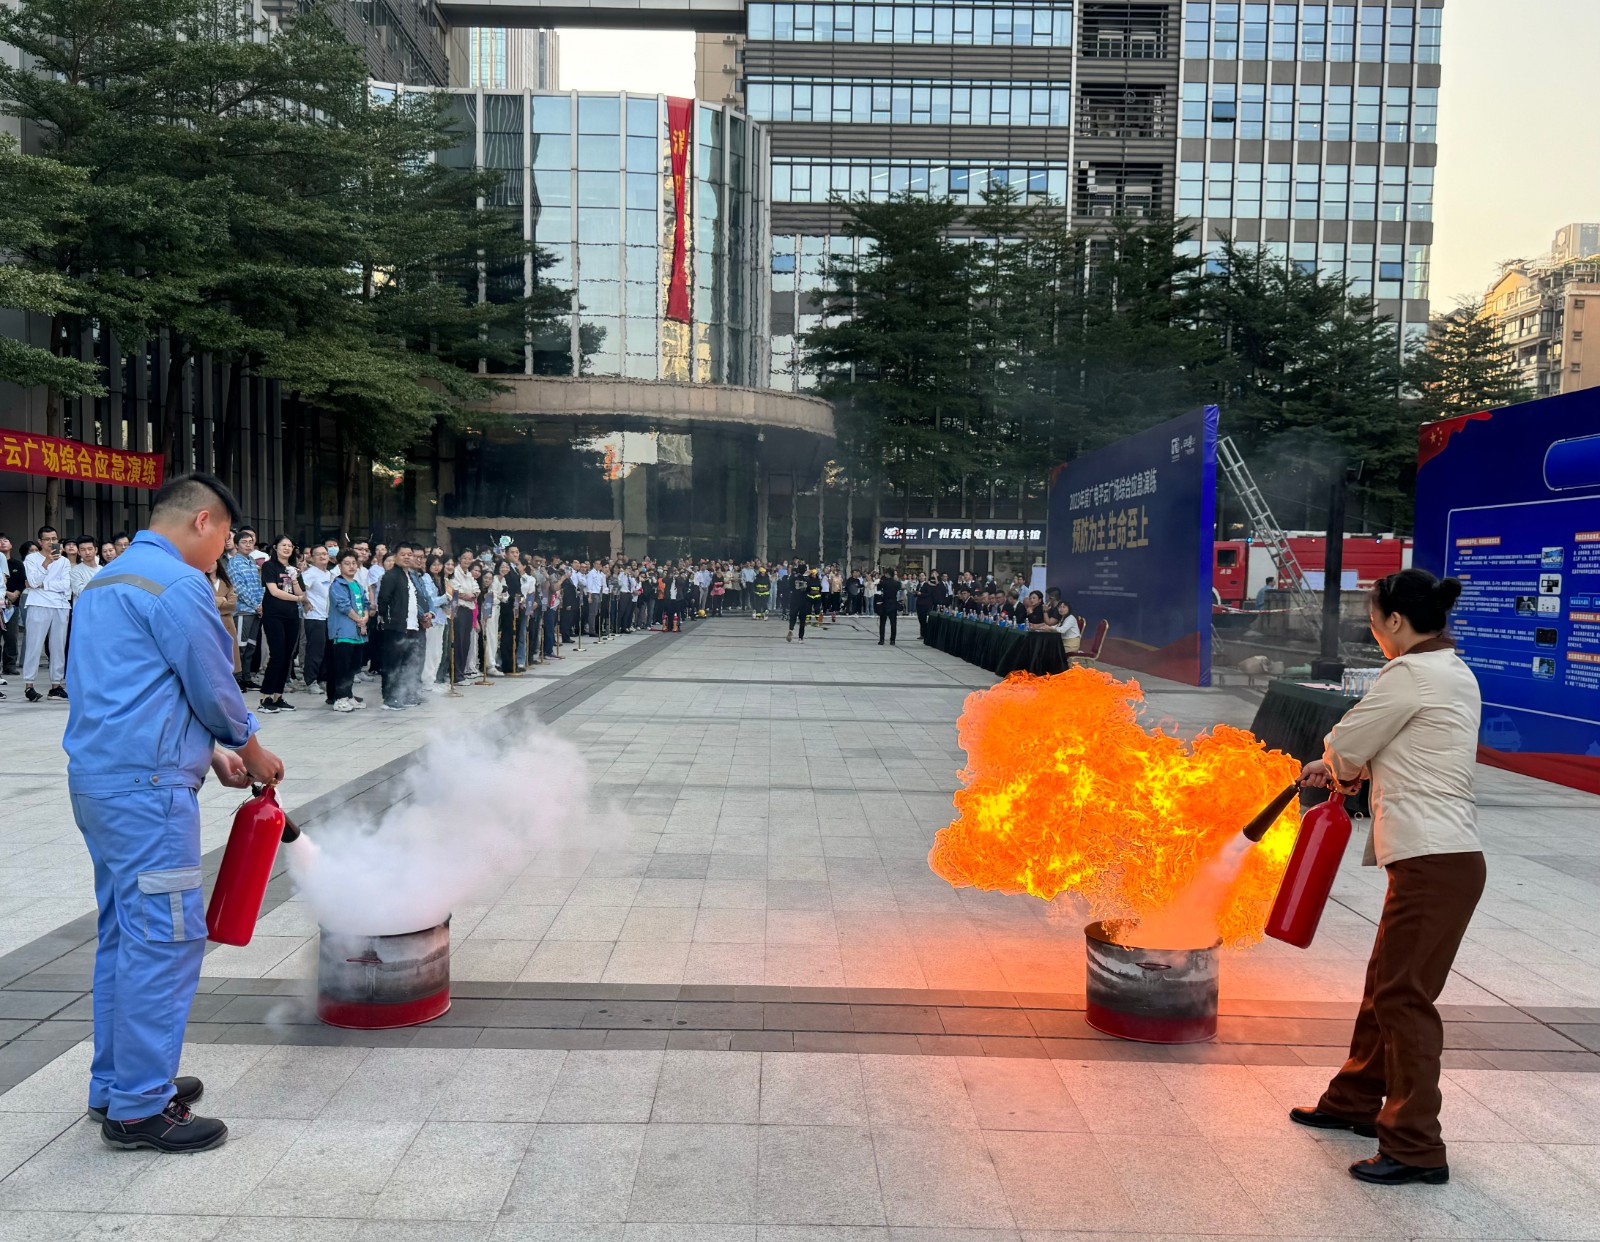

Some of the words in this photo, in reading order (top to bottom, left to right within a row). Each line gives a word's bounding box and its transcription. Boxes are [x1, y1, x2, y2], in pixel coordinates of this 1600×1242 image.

[0, 436, 156, 485] 云广场综合应急演练
[1071, 512, 1106, 554] 预防为主
[1107, 504, 1149, 550] 生命至上
